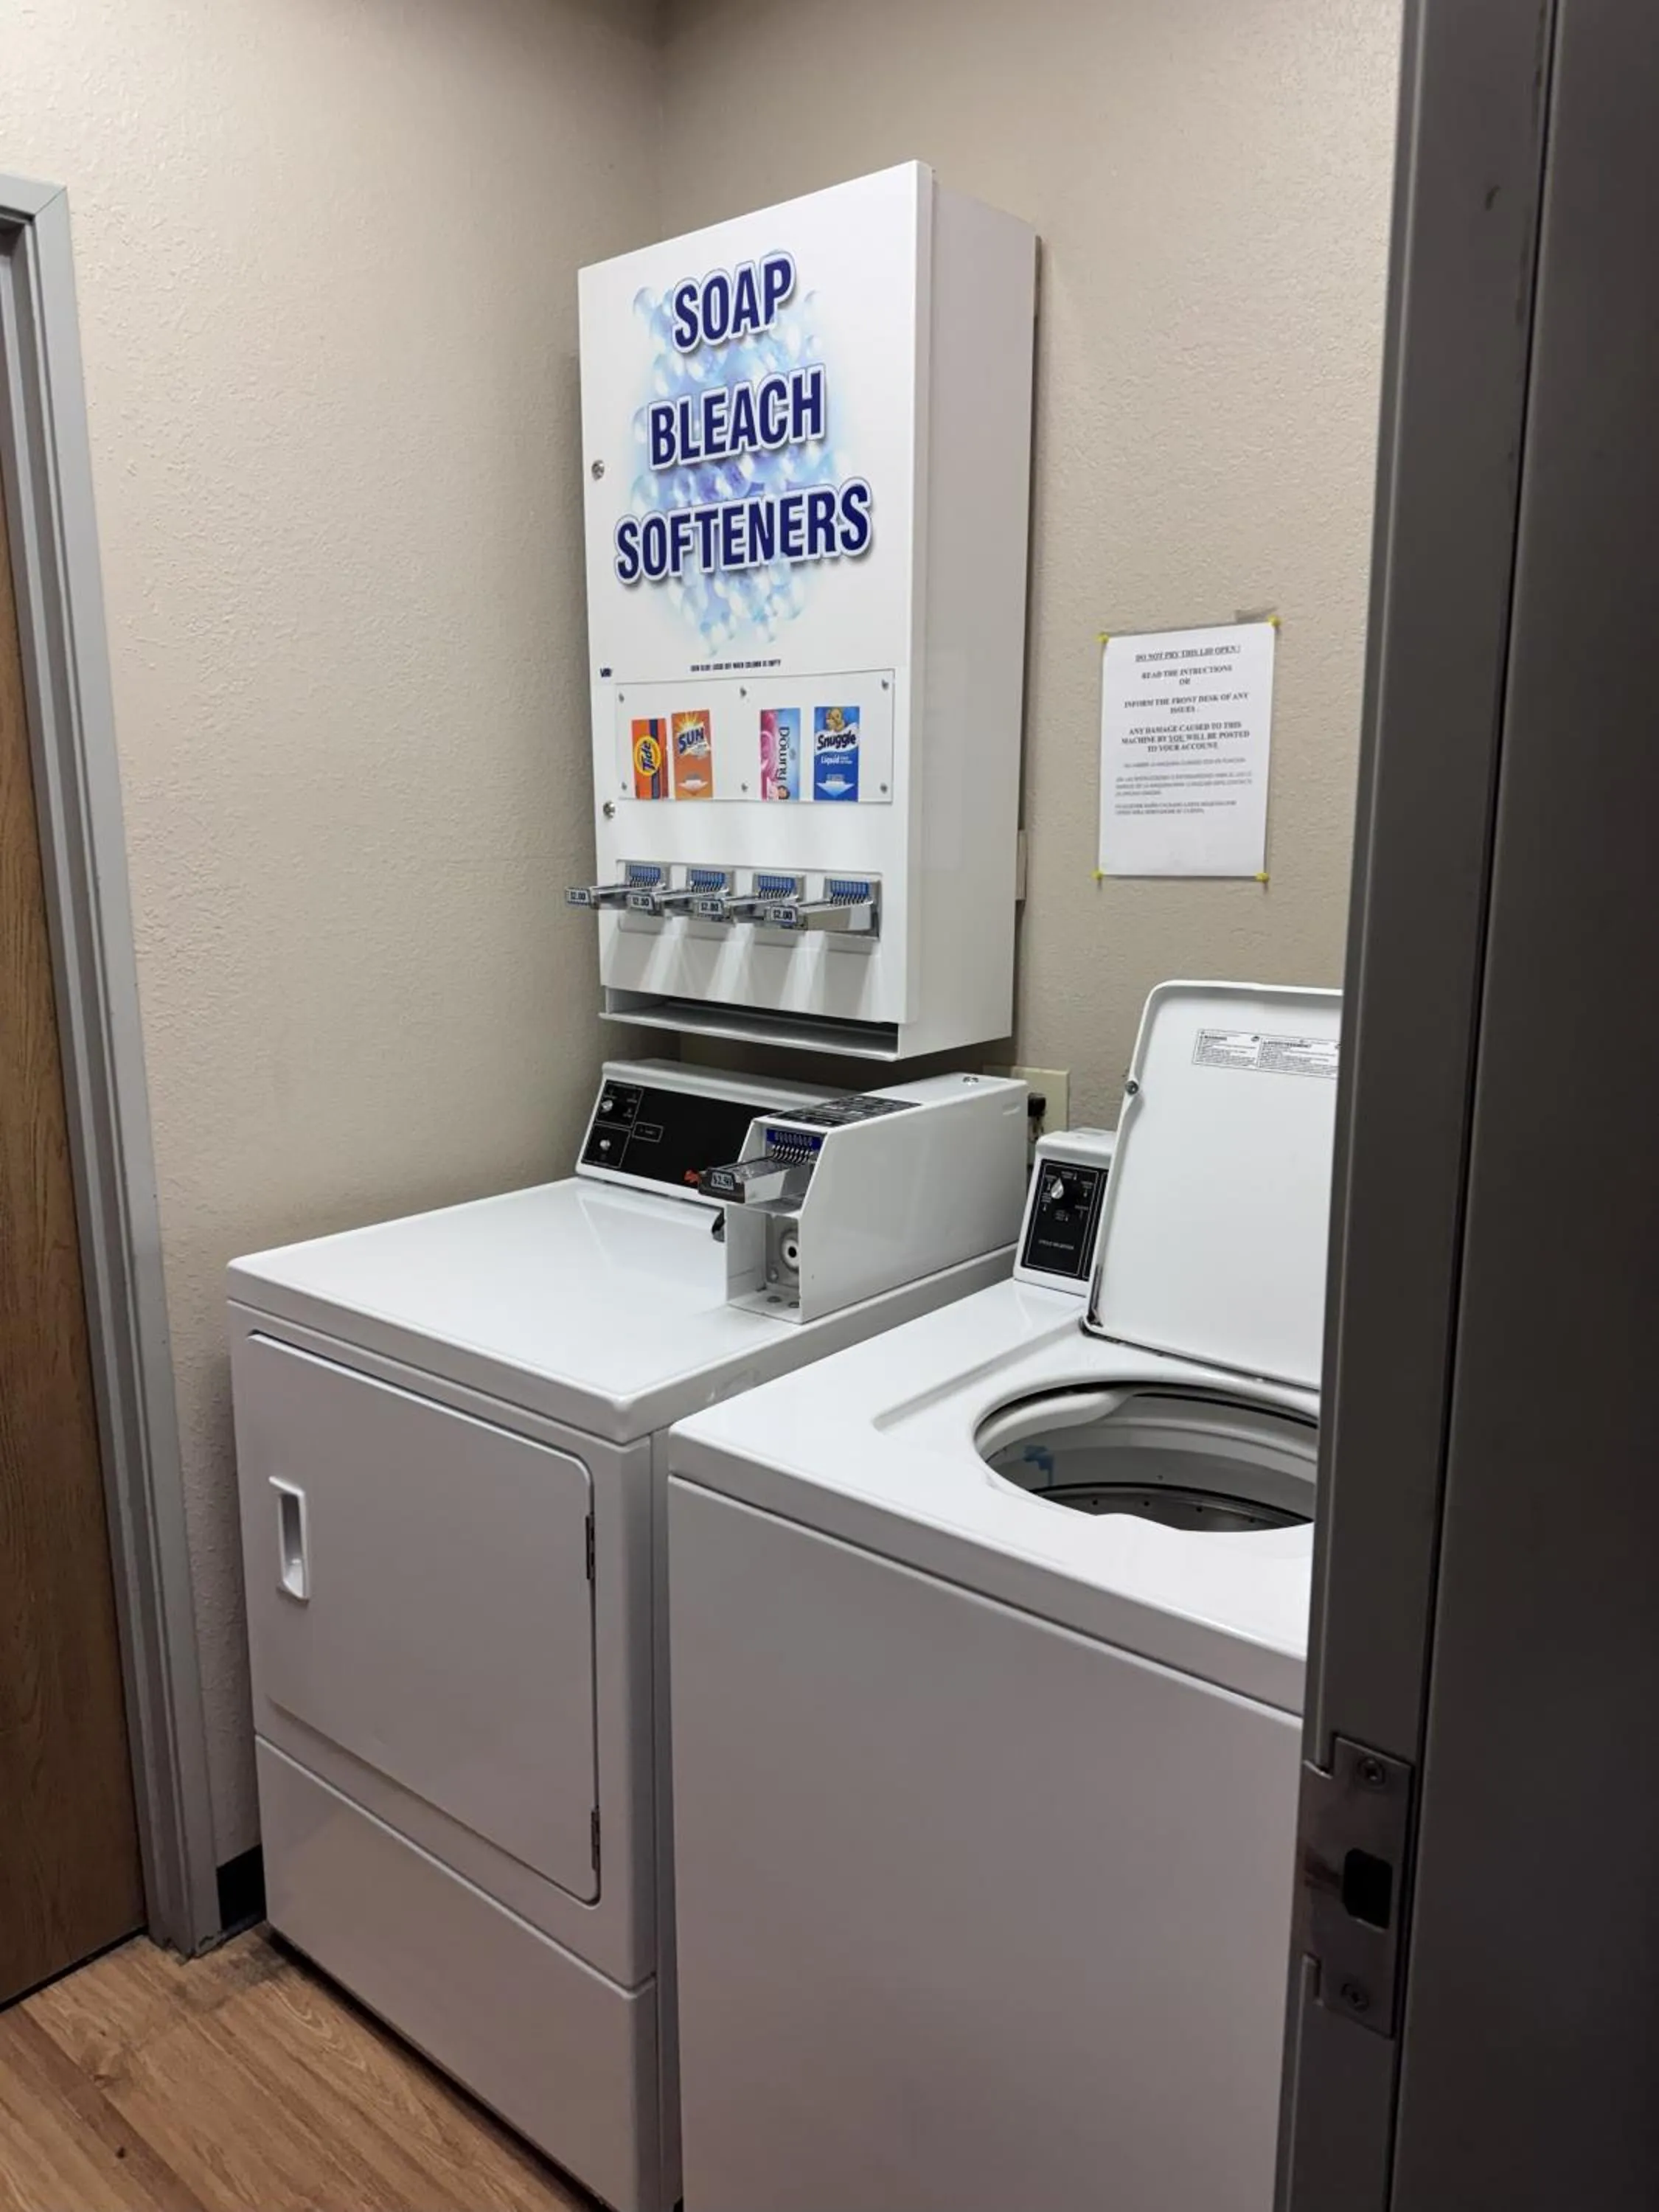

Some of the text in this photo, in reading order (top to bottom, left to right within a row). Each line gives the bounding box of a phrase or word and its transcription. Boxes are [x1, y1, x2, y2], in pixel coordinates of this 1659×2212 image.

[673, 255, 793, 349] SOAP
[649, 367, 824, 467] BLEACH
[615, 481, 870, 580] SOFTENERS
[1135, 654, 1146, 662] DO
[1148, 653, 1163, 661] NOT
[1181, 649, 1198, 658] THIS
[1215, 645, 1237, 655] OPEN
[1124, 692, 1248, 708] INFORM THE FRONT DESK OF ANY
[1121, 736, 1155, 744] MACHINE
[1158, 735, 1167, 743] BY
[1186, 733, 1205, 741] WILL
[1207, 732, 1217, 740] BE
[1219, 730, 1250, 739] POSTED
[1129, 727, 1144, 735] ANY
[1145, 725, 1178, 734] DAMAGE
[1179, 723, 1209, 731] CAUSED
[678, 726, 704, 754] SUN
[816, 730, 856, 751] Snuggle
[1159, 744, 1179, 752] YOUR
[1180, 742, 1218, 751] ACCOUNT
[641, 740, 655, 771] Tide
[775, 726, 790, 781] Downy
[821, 754, 840, 765] Liquid
